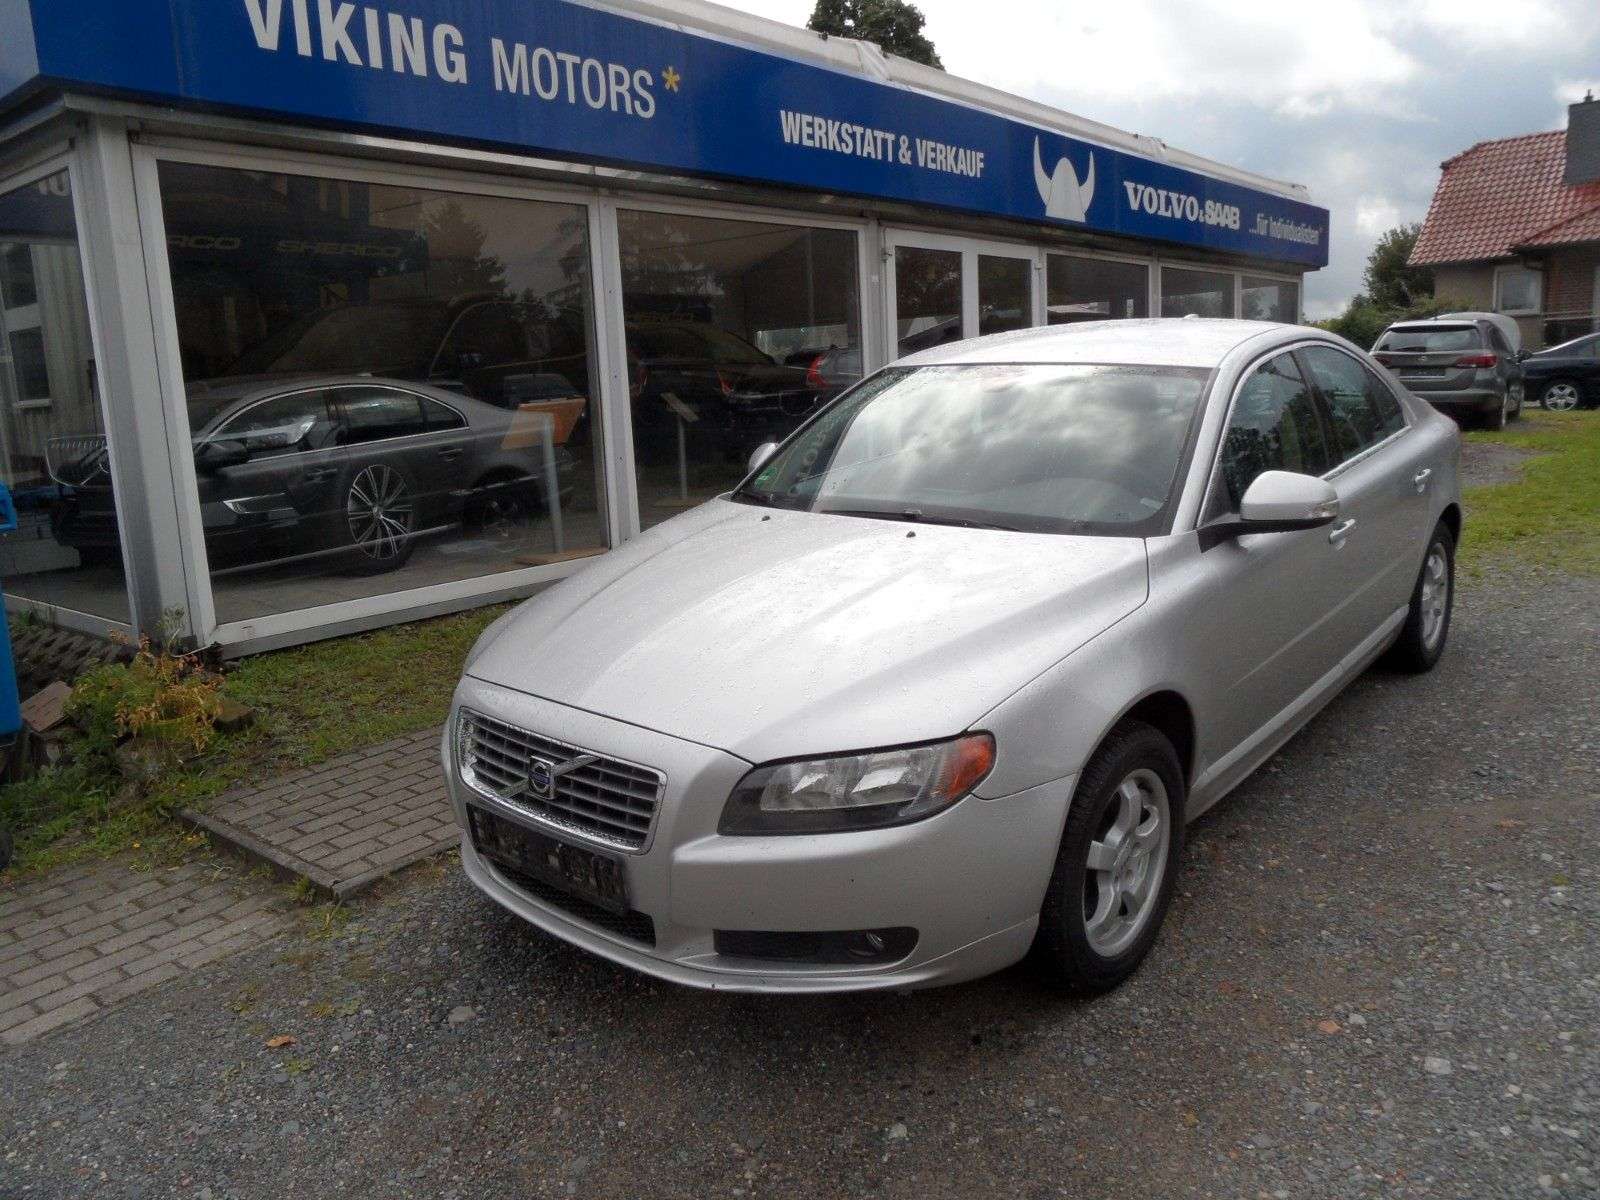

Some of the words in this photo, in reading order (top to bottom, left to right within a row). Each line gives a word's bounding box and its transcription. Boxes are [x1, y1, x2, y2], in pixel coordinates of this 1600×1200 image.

[243, 0, 468, 85] VIKING
[491, 37, 656, 119] MOTORS
[780, 109, 896, 162] WERKSTATT
[898, 134, 912, 166] &
[916, 138, 984, 178] VERKAUF
[1123, 181, 1199, 222] VOLVO
